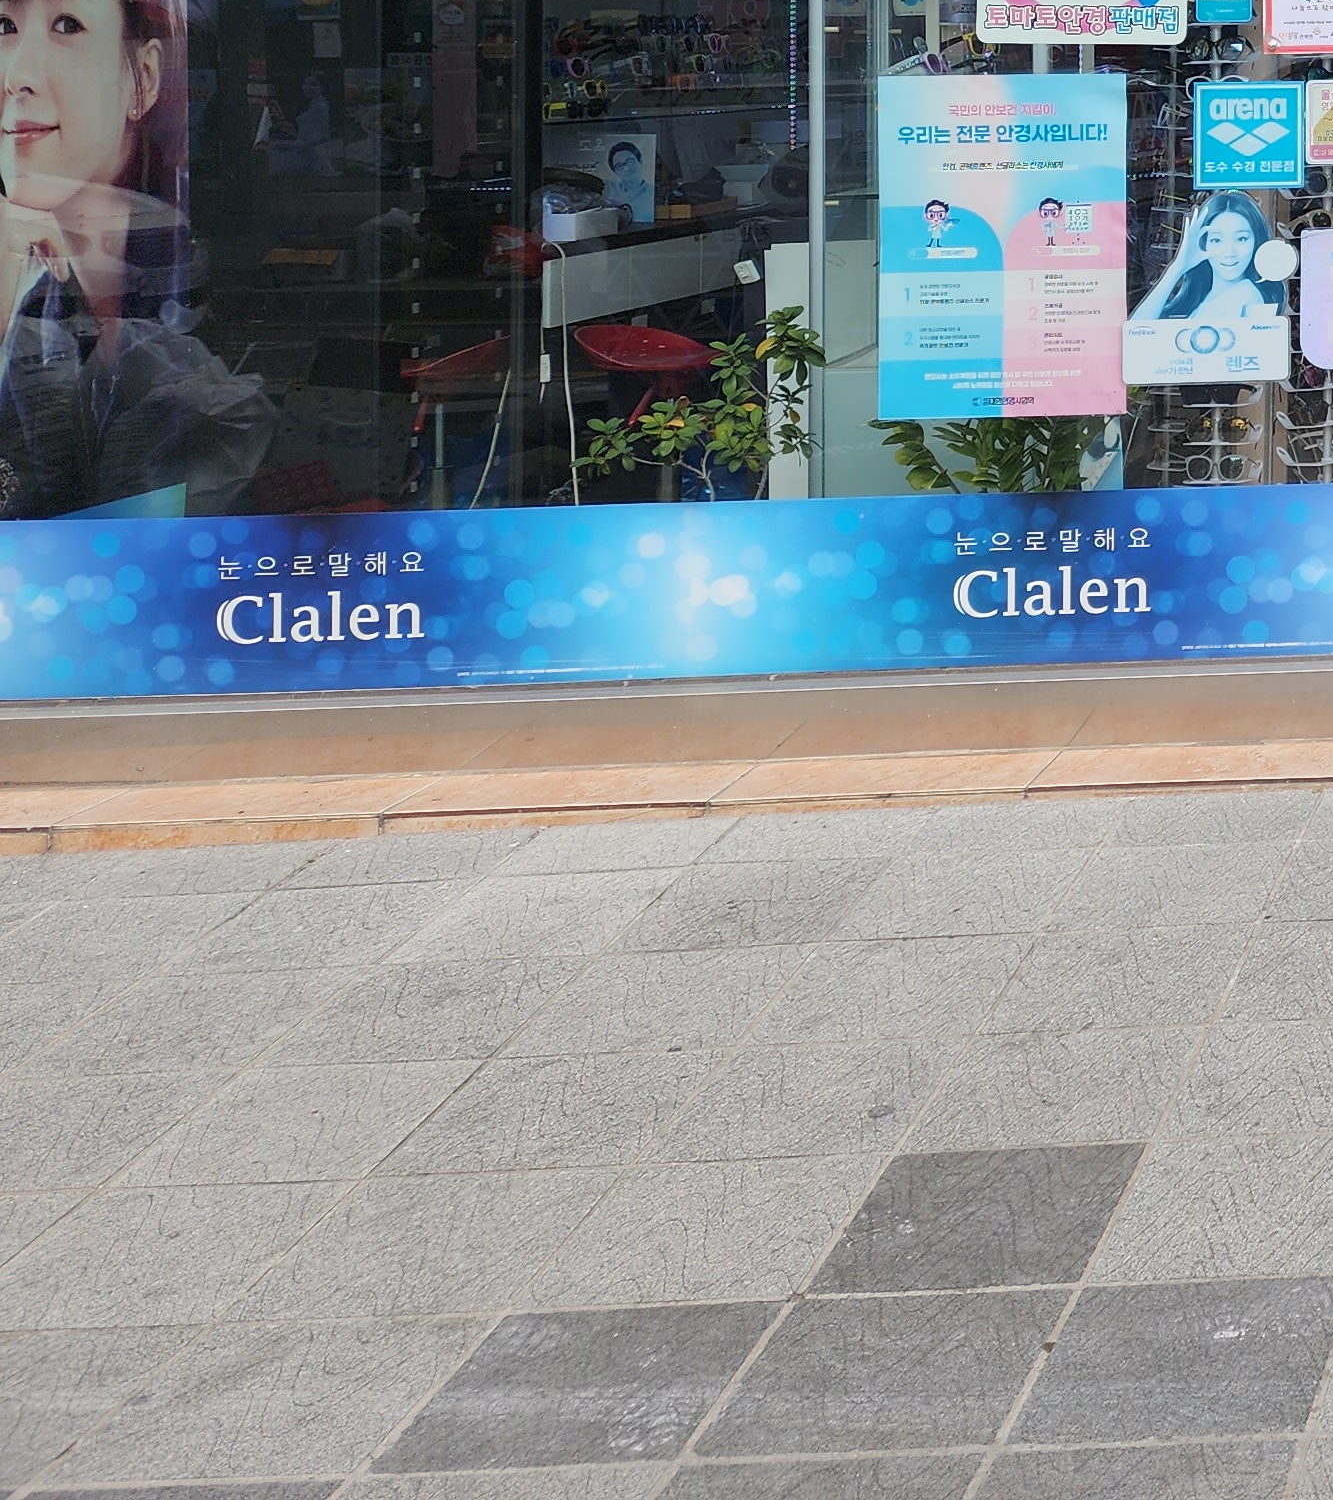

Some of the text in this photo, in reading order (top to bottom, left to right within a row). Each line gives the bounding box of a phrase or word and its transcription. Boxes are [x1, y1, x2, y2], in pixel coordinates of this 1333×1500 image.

[984, 4, 1179, 36] 토마토안경 판매점
[949, 104, 982, 116] 국민의
[985, 104, 1018, 116] 안보건
[1209, 98, 1287, 120] arena
[898, 123, 1108, 144] 우리는 전문 안경사입니다!
[1204, 160, 1295, 173] 도수 수경 전문점
[1226, 356, 1260, 373] 렌즈
[952, 565, 1152, 619] Clalen
[216, 591, 425, 645] Clalen
